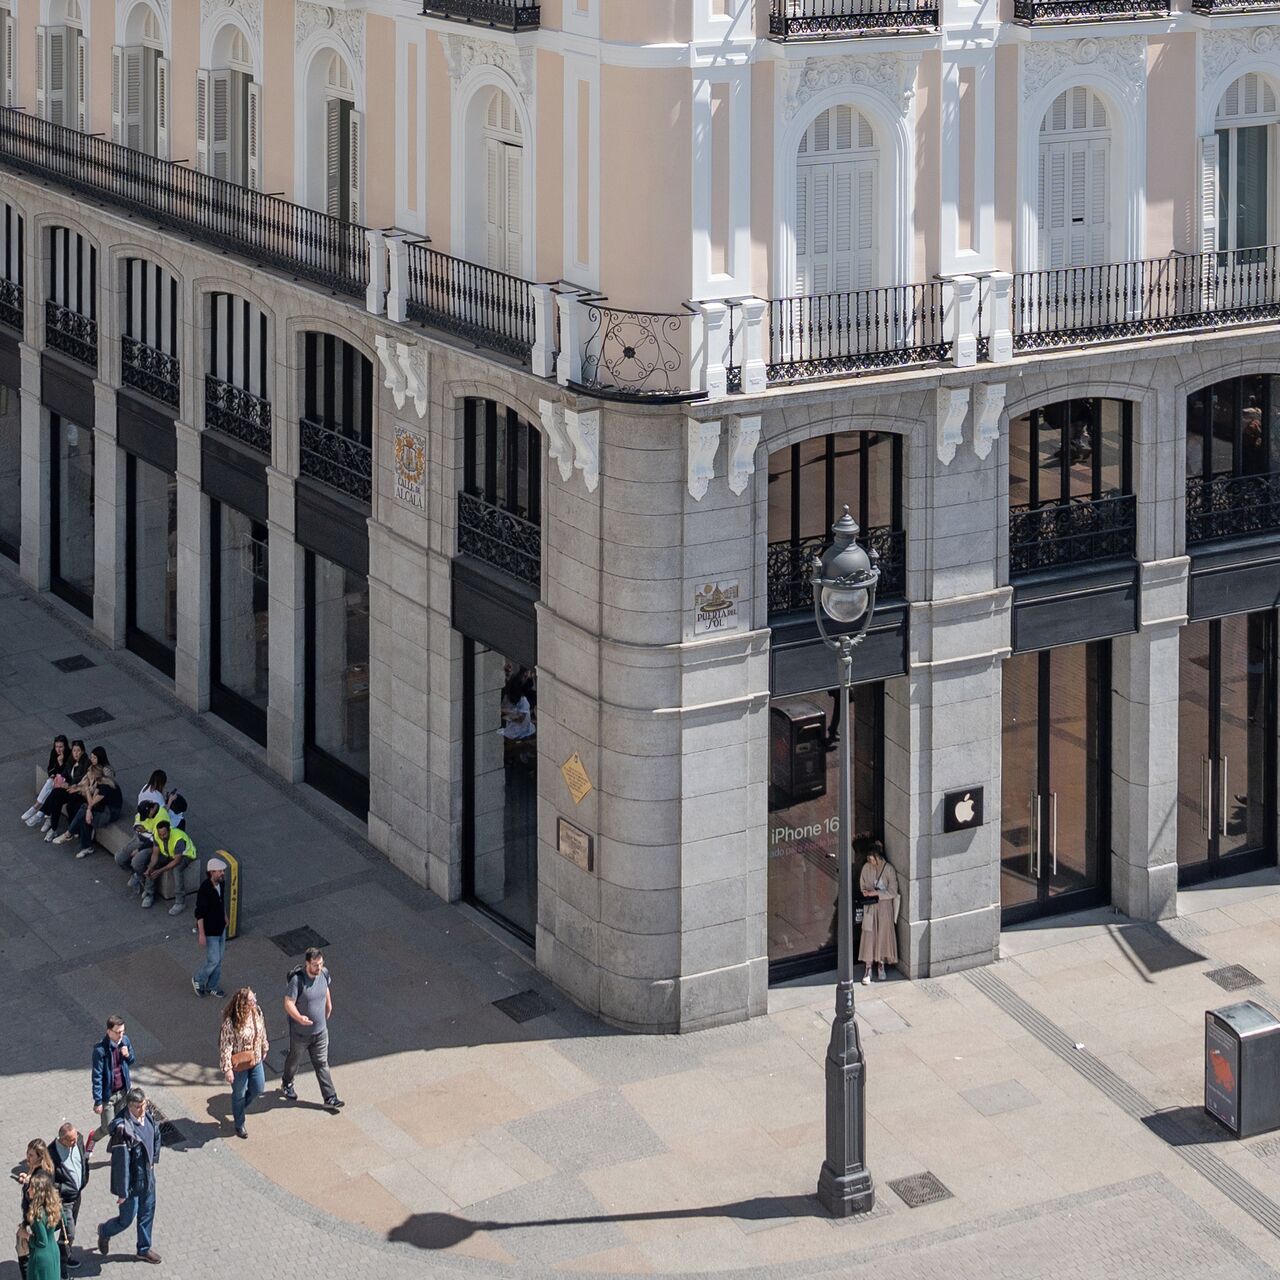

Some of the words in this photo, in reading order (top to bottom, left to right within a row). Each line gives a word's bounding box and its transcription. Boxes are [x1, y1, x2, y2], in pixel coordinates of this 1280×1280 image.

[398, 477, 415, 492] CALLE
[697, 609, 727, 622] PUERTA
[706, 618, 725, 630] SOL
[771, 824, 822, 845] iPhone
[824, 816, 840, 832] 16
